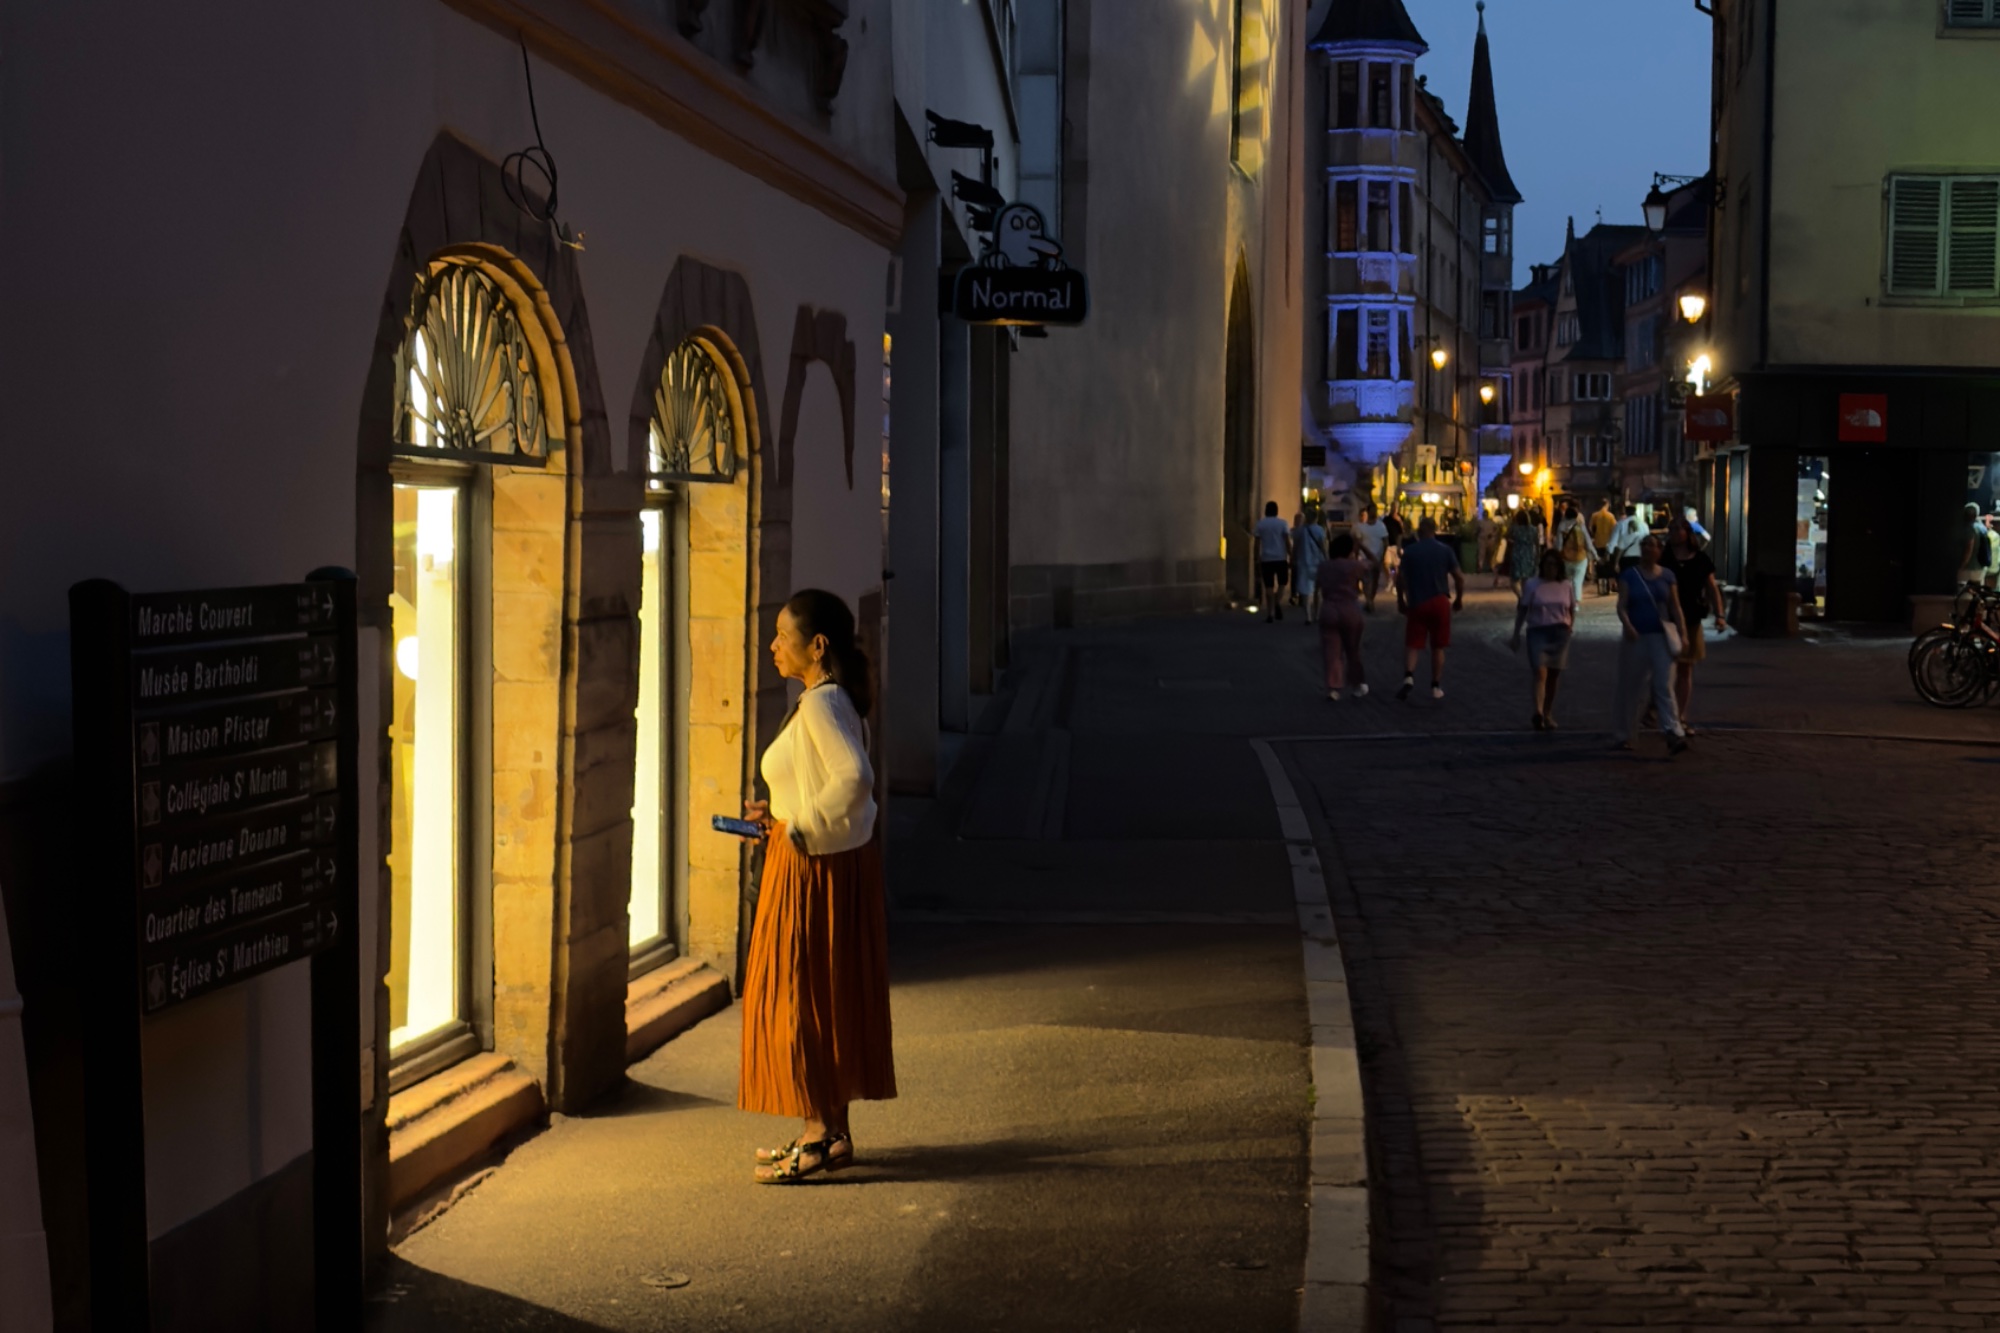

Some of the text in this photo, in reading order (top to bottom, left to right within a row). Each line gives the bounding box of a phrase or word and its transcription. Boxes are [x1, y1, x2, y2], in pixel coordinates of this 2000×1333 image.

[971, 276, 1072, 310] Normal
[138, 601, 253, 637] Marché Couvert
[140, 664, 188, 698] Musée
[194, 655, 259, 690] Bartholdi
[167, 723, 218, 756] Maison
[224, 715, 271, 745] Pfister
[167, 774, 230, 815] Collégiale
[249, 764, 288, 796] Martin
[168, 837, 234, 875] Ancienne
[239, 823, 287, 856] Douane
[145, 880, 283, 943] Quartier des Tanneurs
[171, 956, 212, 999] Église
[233, 933, 290, 972] Matthieu
